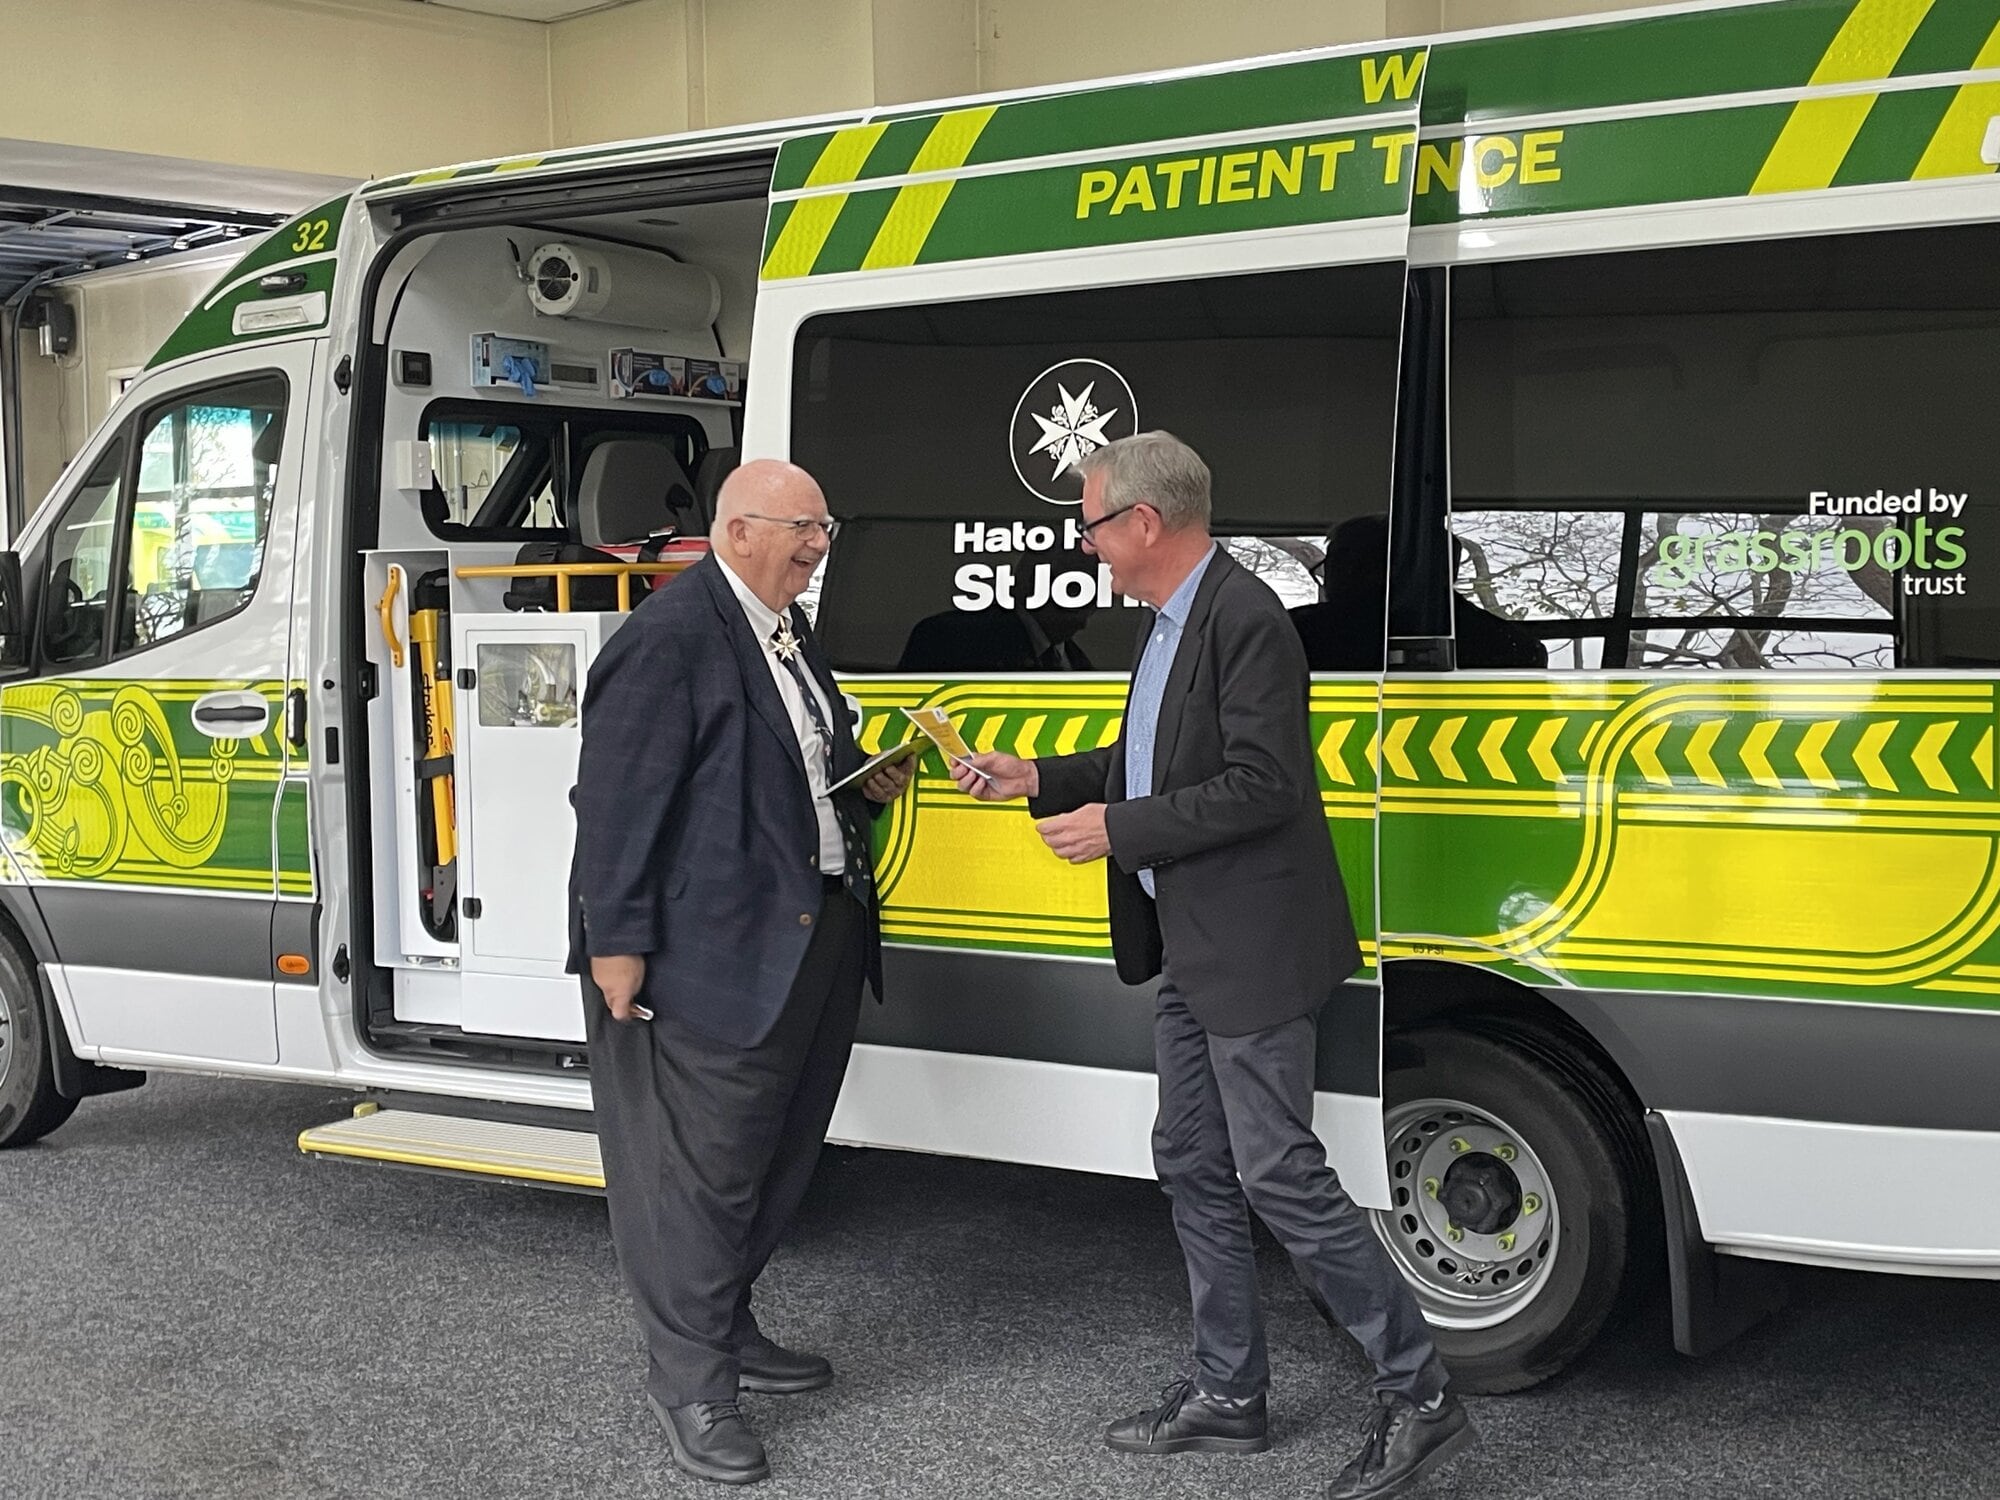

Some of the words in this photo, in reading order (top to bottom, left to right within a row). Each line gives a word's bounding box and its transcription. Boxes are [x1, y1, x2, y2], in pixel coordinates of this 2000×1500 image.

[1076, 139, 1355, 219] PATIENT
[292, 220, 329, 252] 32
[1809, 489, 1921, 515] Funded
[1929, 488, 1967, 518] by
[954, 521, 1055, 553] Hato
[1659, 515, 1967, 588] grassroots
[952, 563, 1015, 611] St
[1903, 572, 1966, 595] trust
[1427, 944, 1444, 955] PSI
